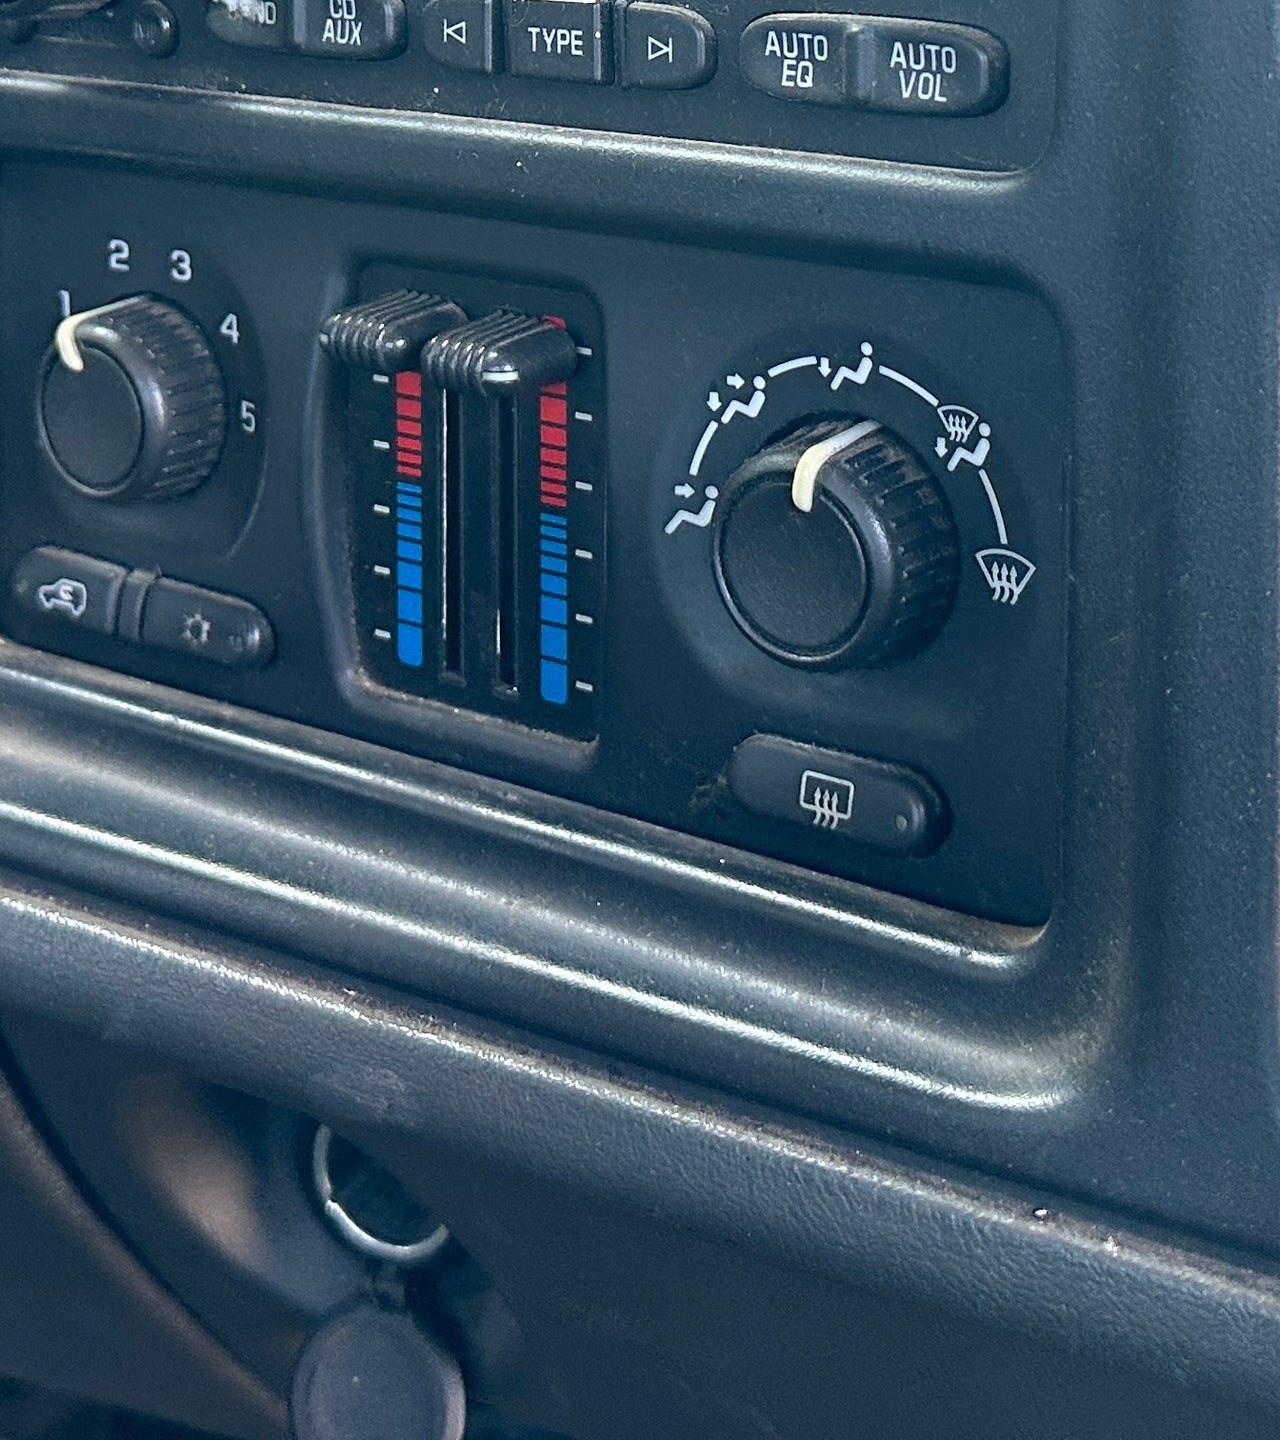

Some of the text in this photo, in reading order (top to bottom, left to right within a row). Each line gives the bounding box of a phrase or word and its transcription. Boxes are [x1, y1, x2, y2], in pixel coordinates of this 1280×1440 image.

[322, 18, 363, 47] AUX
[528, 27, 584, 57] TYPE
[764, 30, 829, 62] AUTO
[781, 60, 814, 89] EQ
[889, 42, 957, 75] AUTO
[898, 70, 948, 103] VOL
[108, 238, 131, 272] 2
[170, 250, 193, 282] 3
[59, 290, 73, 317] 1
[219, 313, 241, 344] 4
[241, 401, 257, 433] 5
